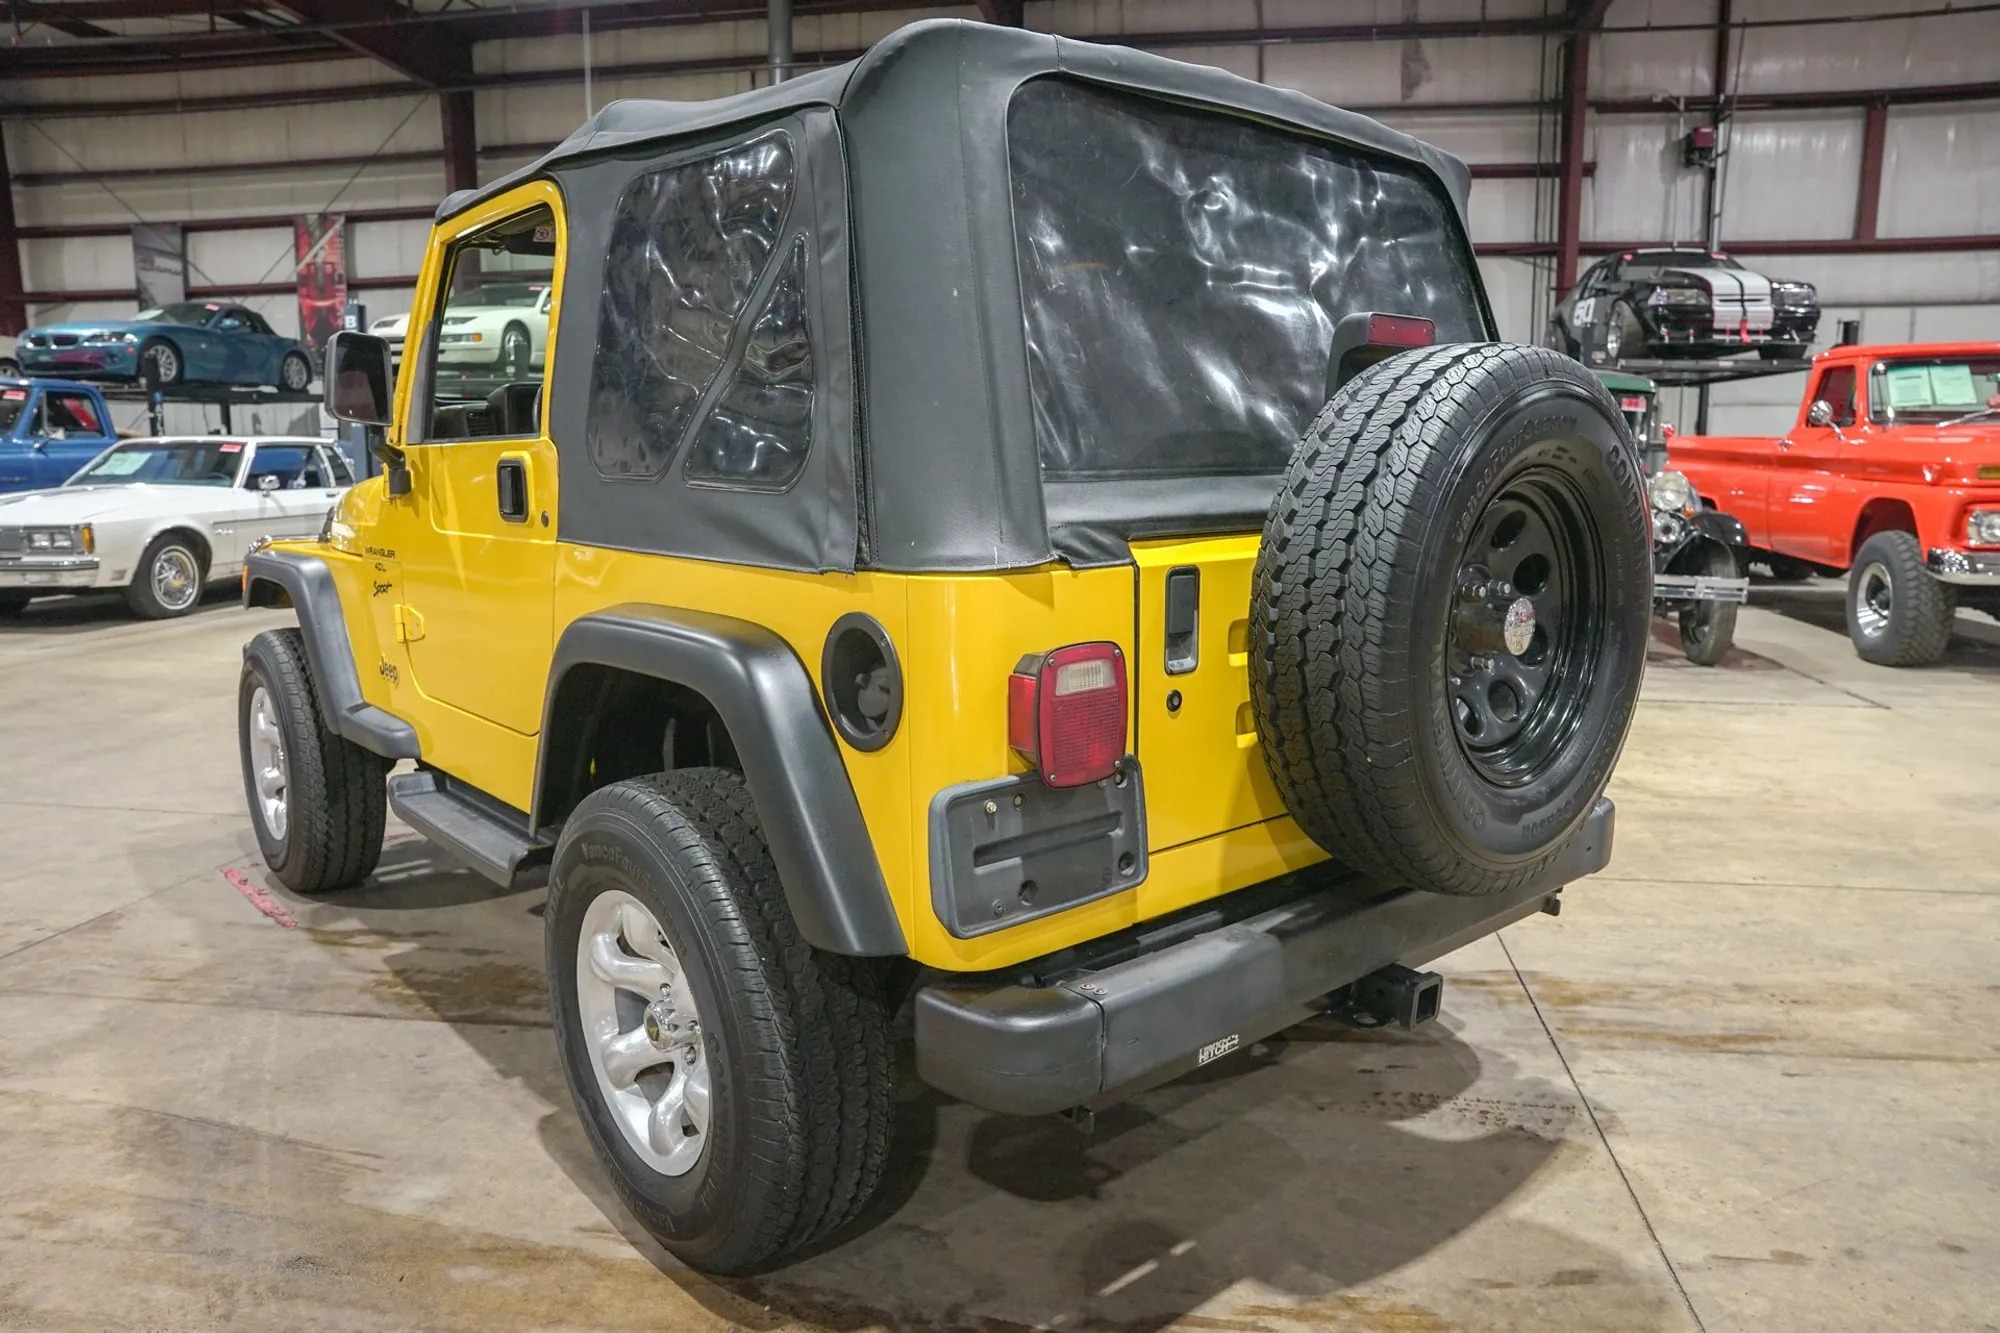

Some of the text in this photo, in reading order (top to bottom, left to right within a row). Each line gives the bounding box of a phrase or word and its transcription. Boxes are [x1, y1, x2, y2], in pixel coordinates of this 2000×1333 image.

[1573, 297, 1596, 327] 50
[345, 315, 357, 329] B
[365, 547, 396, 559] WRANGLER
[373, 580, 393, 598] Sport
[379, 655, 400, 683] Jeep
